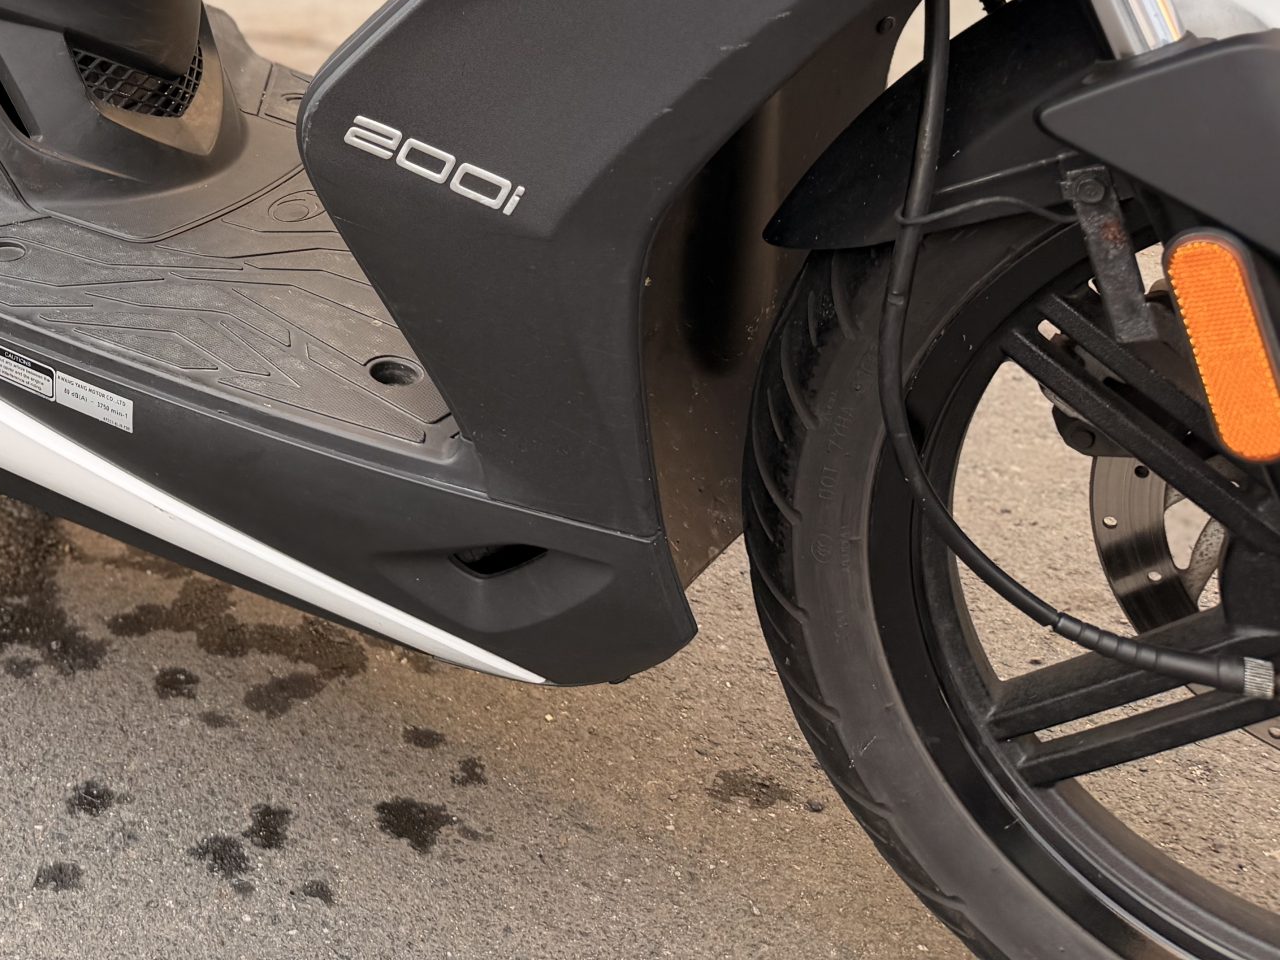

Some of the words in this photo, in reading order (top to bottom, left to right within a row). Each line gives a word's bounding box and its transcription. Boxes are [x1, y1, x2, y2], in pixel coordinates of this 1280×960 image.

[343, 115, 526, 216] 200i
[75, 382, 88, 392] YANG
[88, 388, 106, 399] MOTOR
